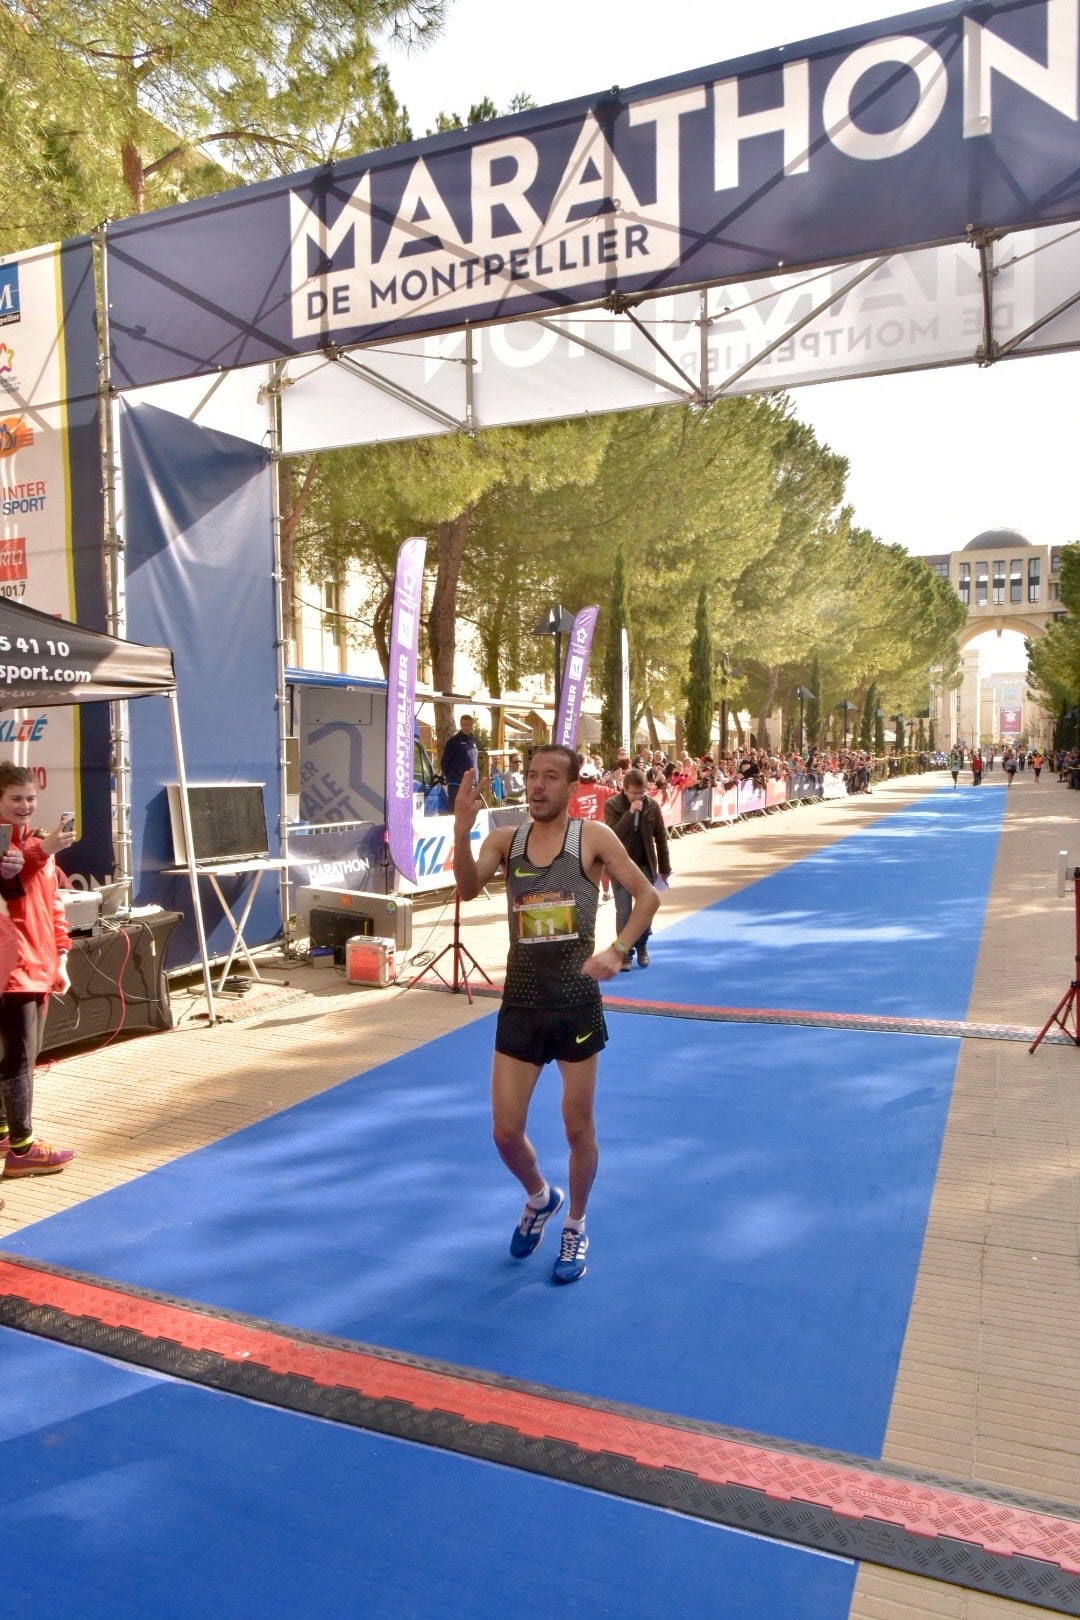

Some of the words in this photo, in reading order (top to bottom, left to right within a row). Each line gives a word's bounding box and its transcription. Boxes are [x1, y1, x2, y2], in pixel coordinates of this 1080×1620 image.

[289, 0, 1078, 276] MARATHON
[307, 285, 350, 320] DE
[370, 224, 650, 309] MONTPELLIER
[3, 481, 46, 500] INTER
[3, 497, 46, 516] SPORT
[17, 637, 39, 654] 41
[47, 640, 70, 657] 10
[0, 664, 92, 684] sport.com
[396, 654, 408, 799] MONTPELLIER
[307, 857, 370, 879] MARATHON
[535, 918, 554, 937] 11
